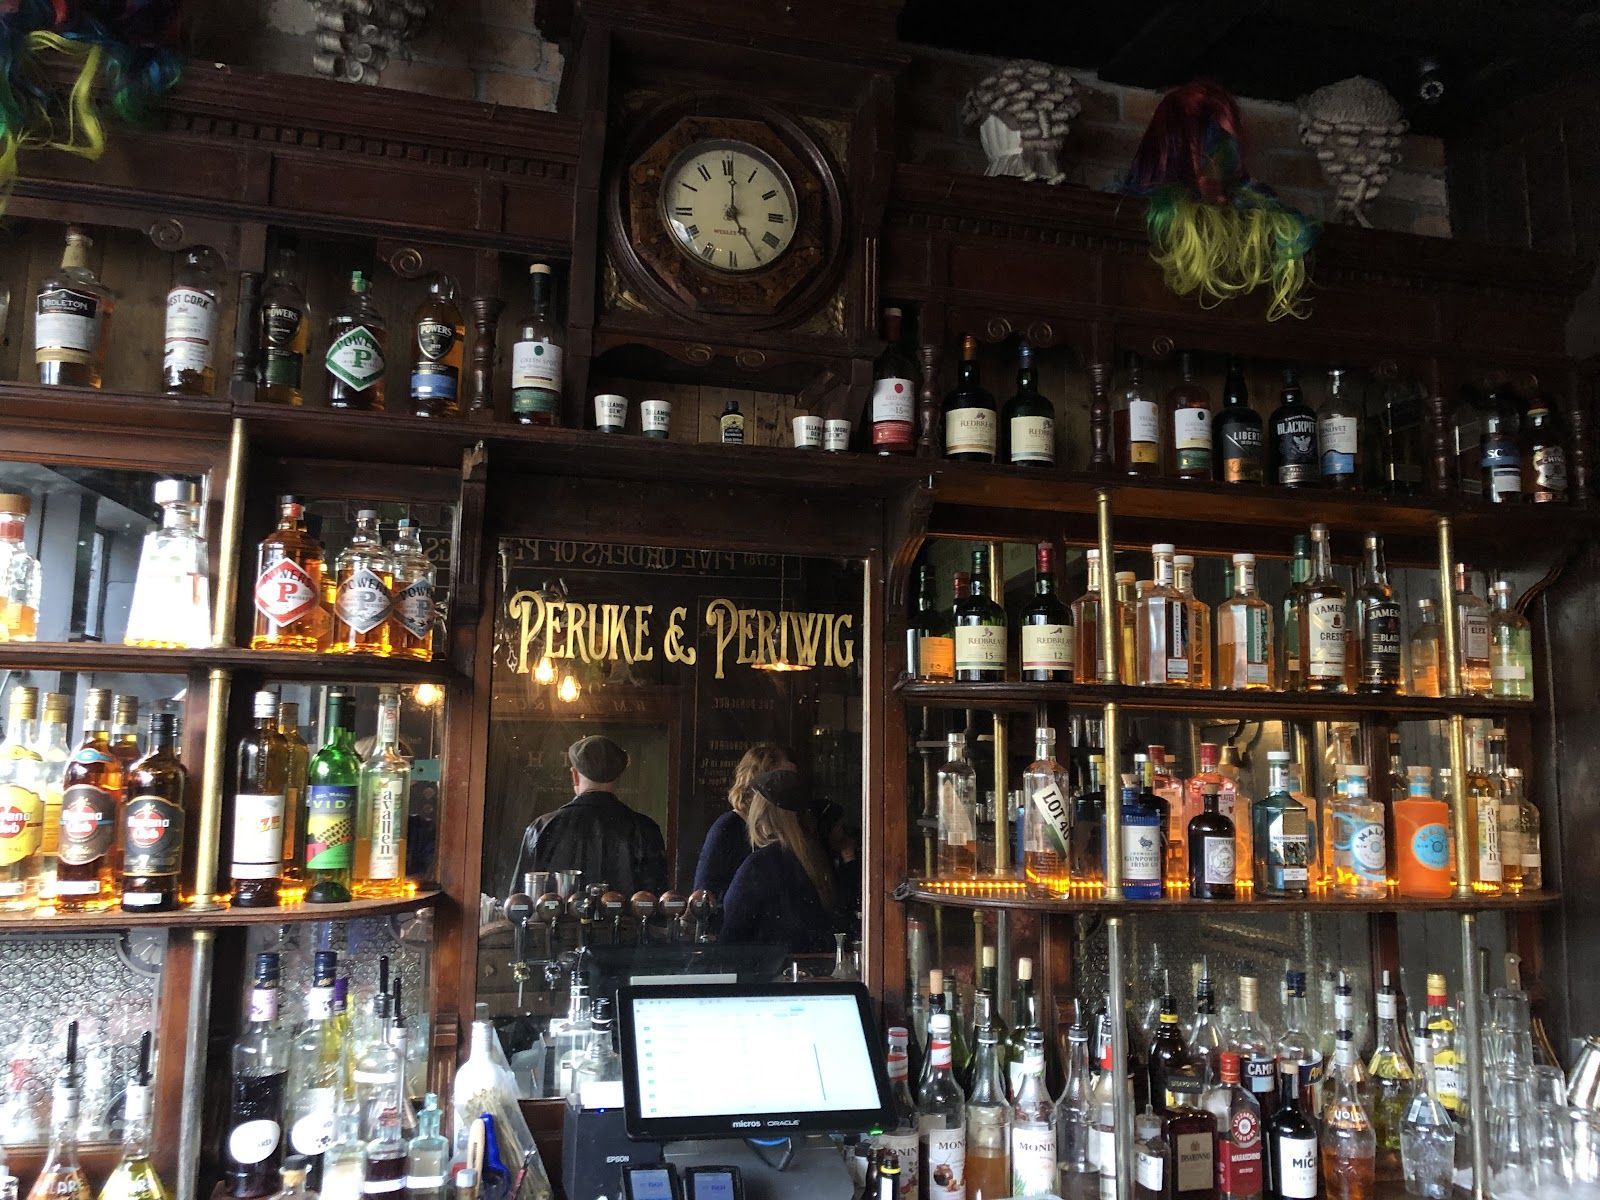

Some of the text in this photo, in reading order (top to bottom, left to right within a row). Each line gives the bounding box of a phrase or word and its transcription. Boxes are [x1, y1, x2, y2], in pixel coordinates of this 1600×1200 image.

[1313, 603, 1345, 616] JAMES
[1369, 607, 1401, 621] JAMES
[509, 589, 855, 680] PERUKE & PERIWIG
[1319, 631, 1345, 642] CREST
[1041, 790, 1067, 825] LOT
[1247, 1062, 1275, 1077] CAMP
[732, 1119, 800, 1128] micros ORACLE
[938, 1141, 966, 1151] MON
[606, 1155, 630, 1163] EPSON
